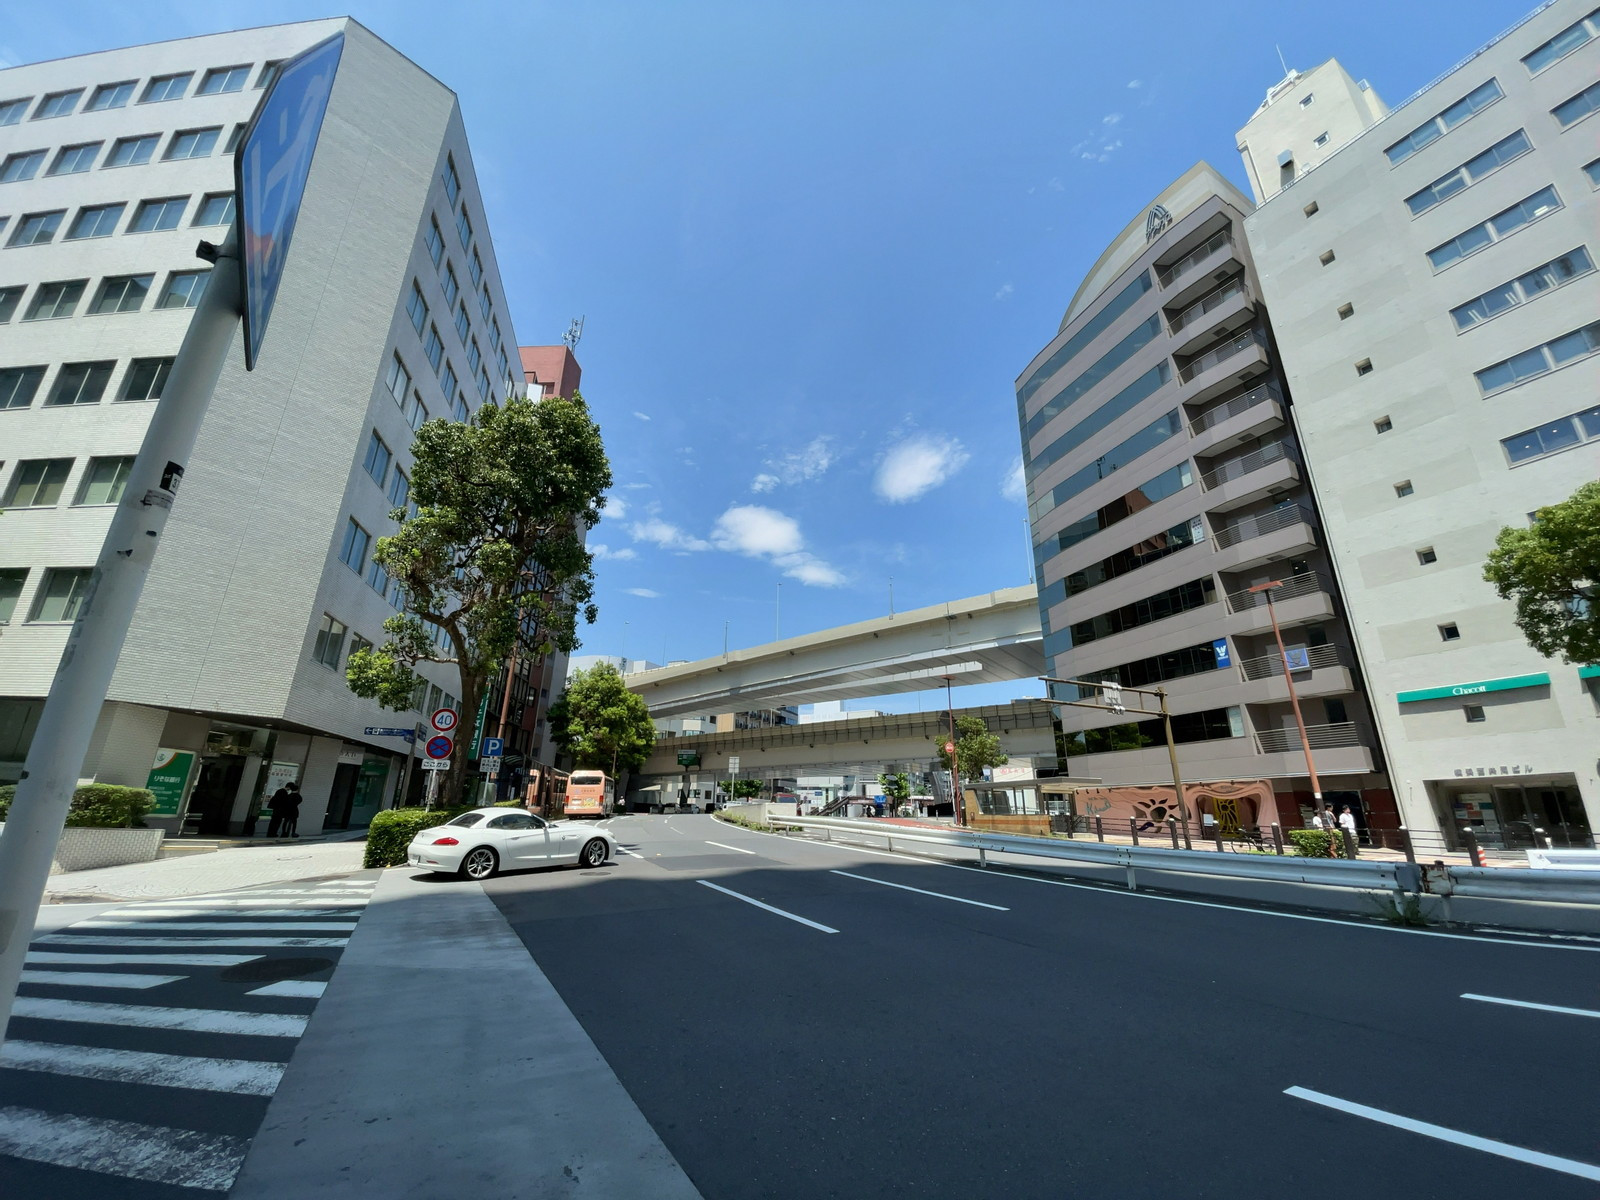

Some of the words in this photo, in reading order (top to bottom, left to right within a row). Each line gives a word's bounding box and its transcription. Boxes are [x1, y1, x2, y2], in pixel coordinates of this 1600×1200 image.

[1452, 685, 1487, 696] Chacott
[437, 715, 453, 726] 40
[487, 739, 500, 755] P
